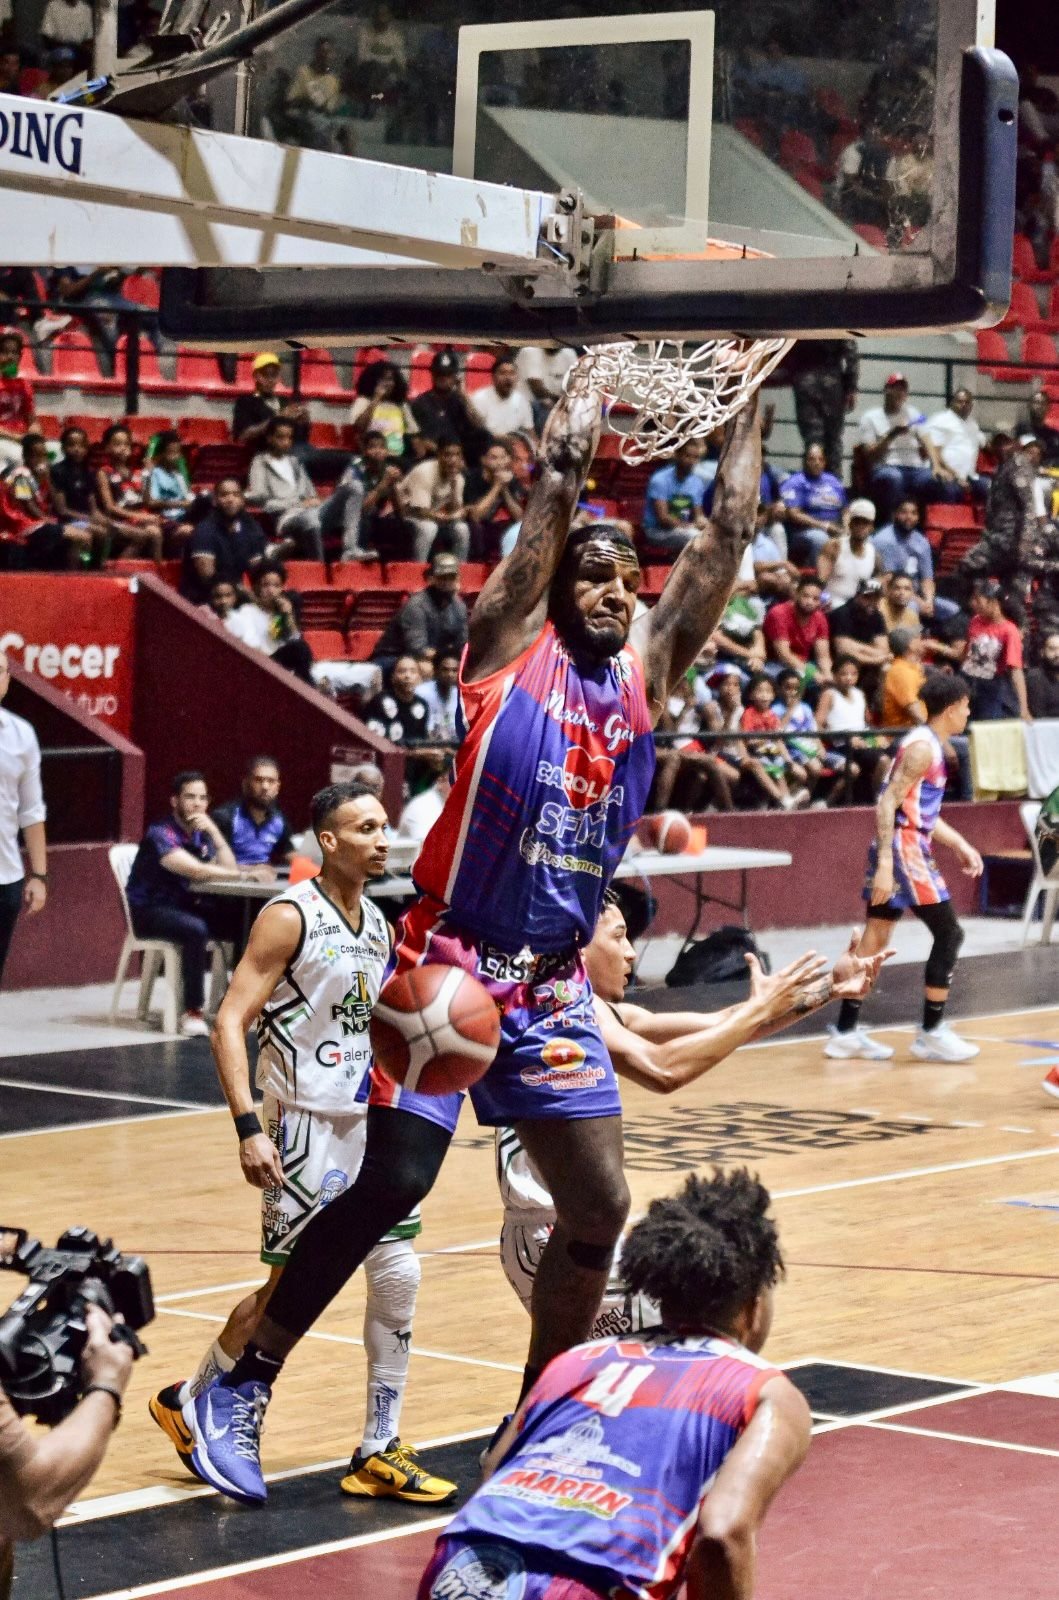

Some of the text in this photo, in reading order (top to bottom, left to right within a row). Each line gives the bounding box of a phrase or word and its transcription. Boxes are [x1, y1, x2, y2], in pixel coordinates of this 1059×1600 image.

[536, 802, 607, 848] SFM
[342, 1016, 369, 1036] NU
[624, 1110, 875, 1152] ARIO
[588, 1317, 632, 1342] emp
[500, 1470, 630, 1513] MARTIN
